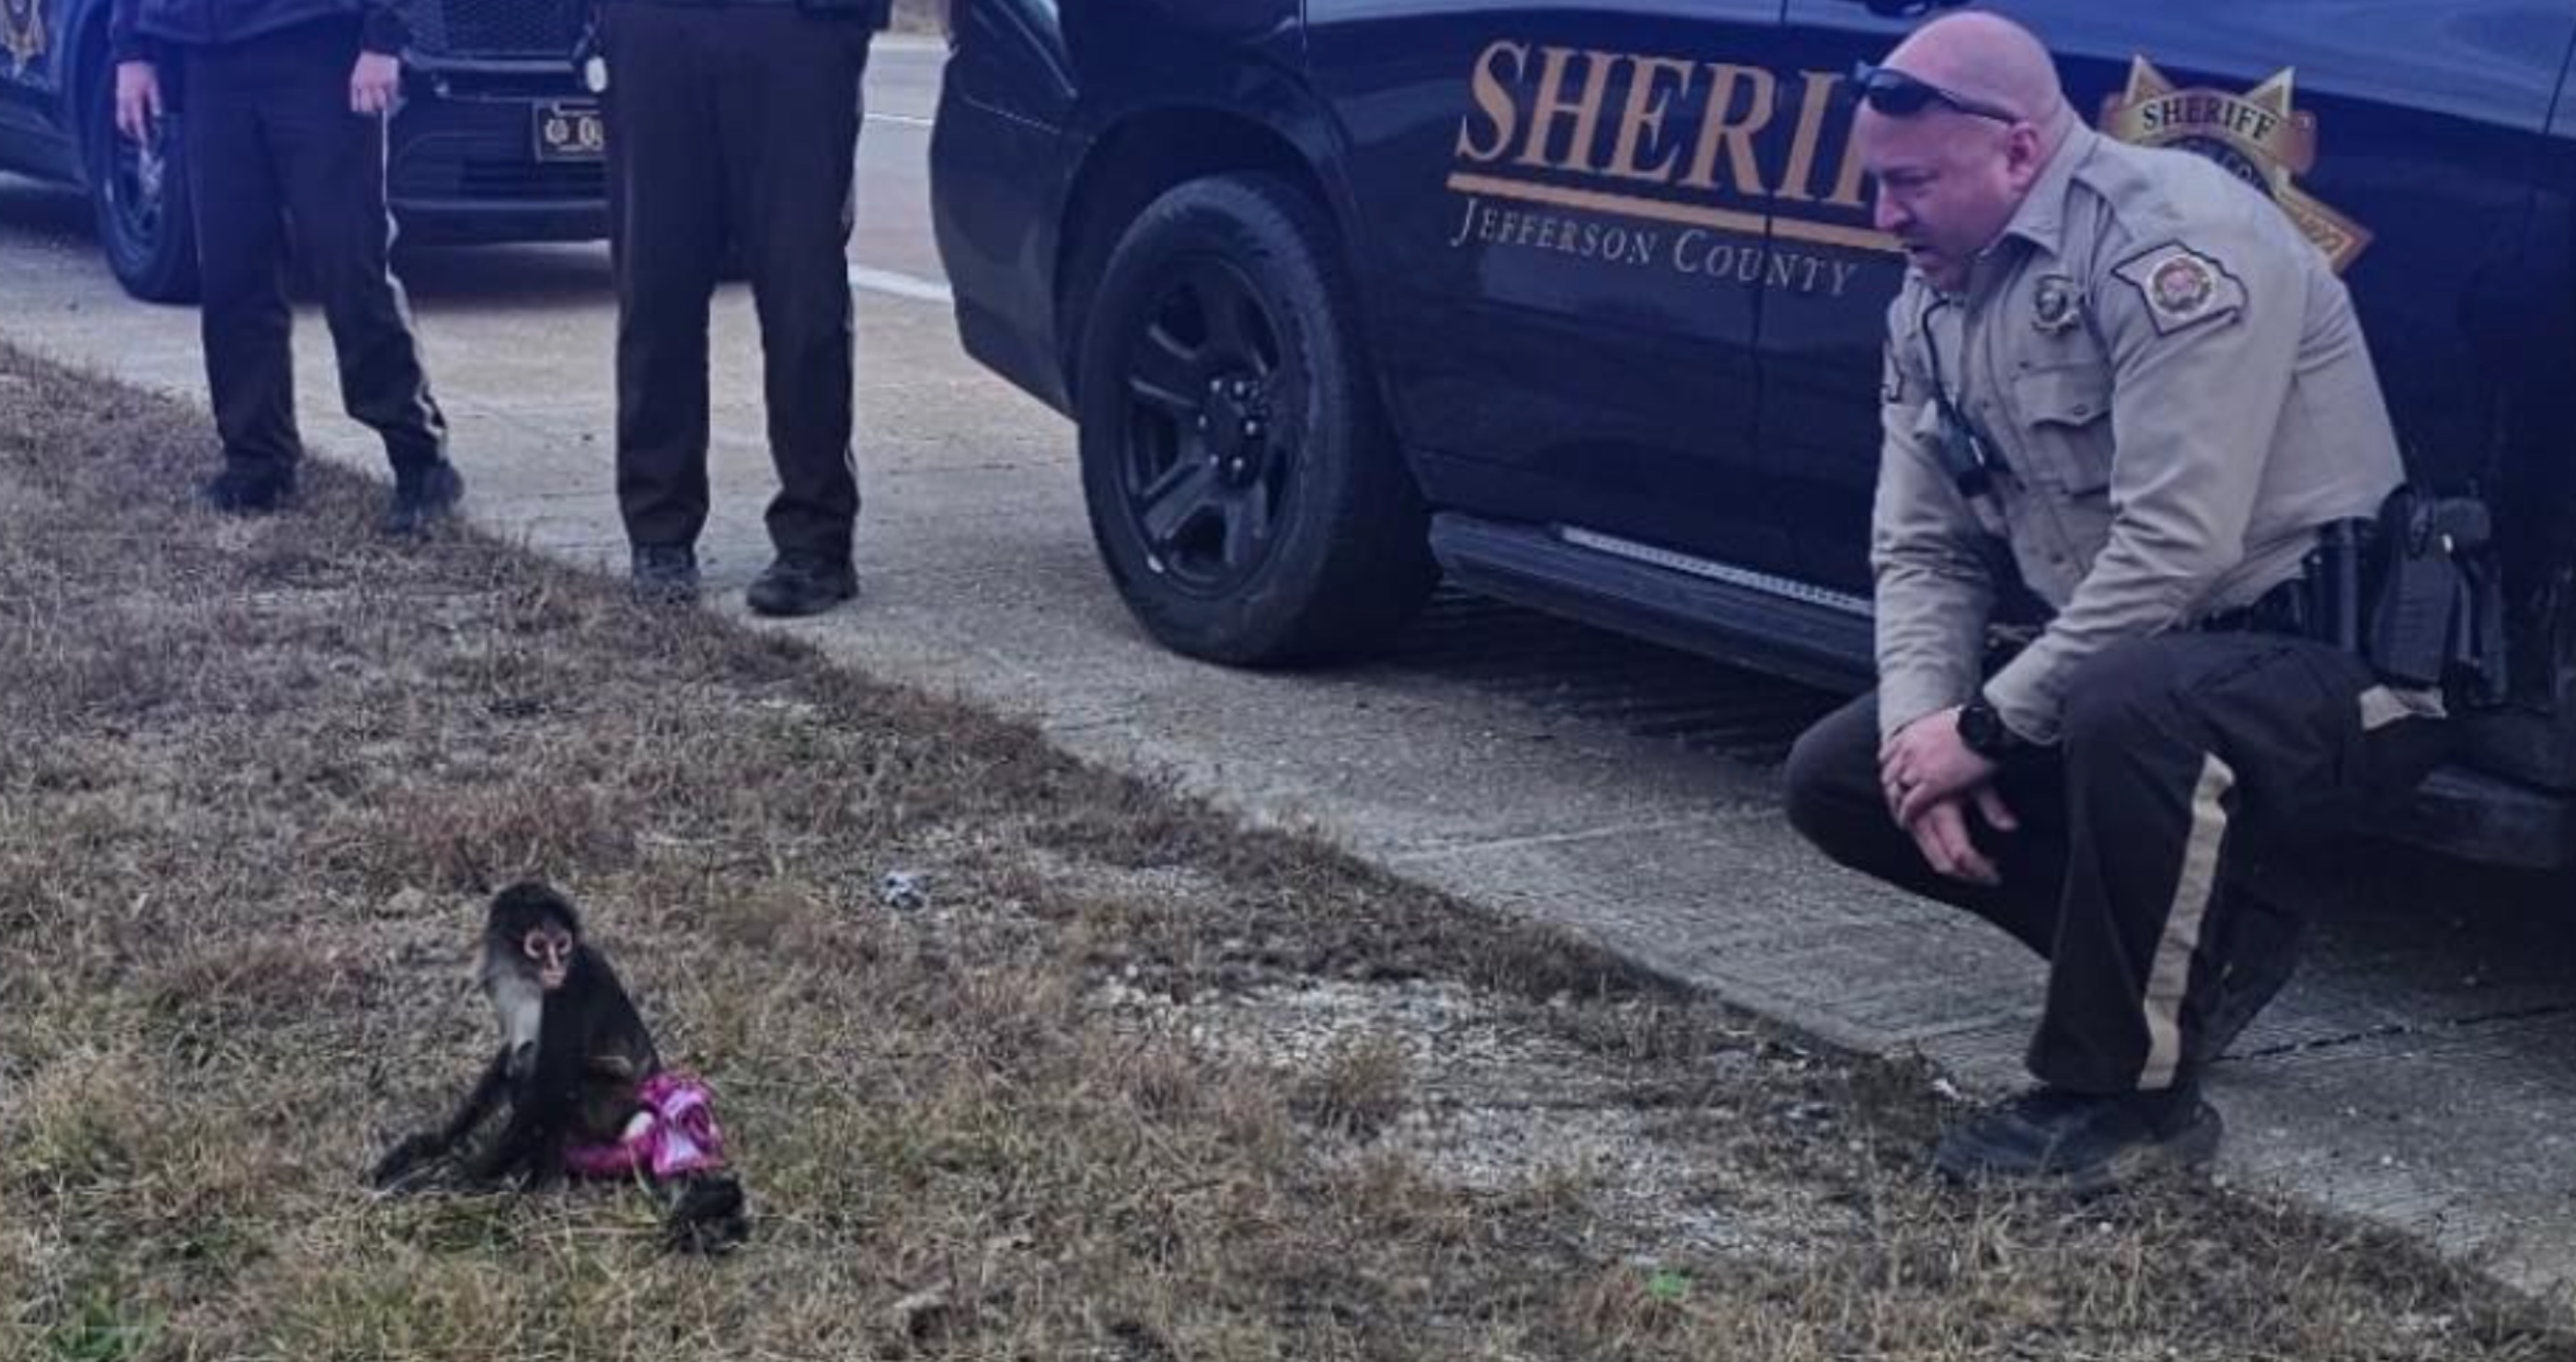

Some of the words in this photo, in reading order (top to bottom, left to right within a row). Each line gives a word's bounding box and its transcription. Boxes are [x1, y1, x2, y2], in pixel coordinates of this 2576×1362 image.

[2142, 95, 2277, 141] SHERIFF
[1450, 197, 1656, 265] JEFFERSON
[1673, 228, 1861, 297] COUNTY
